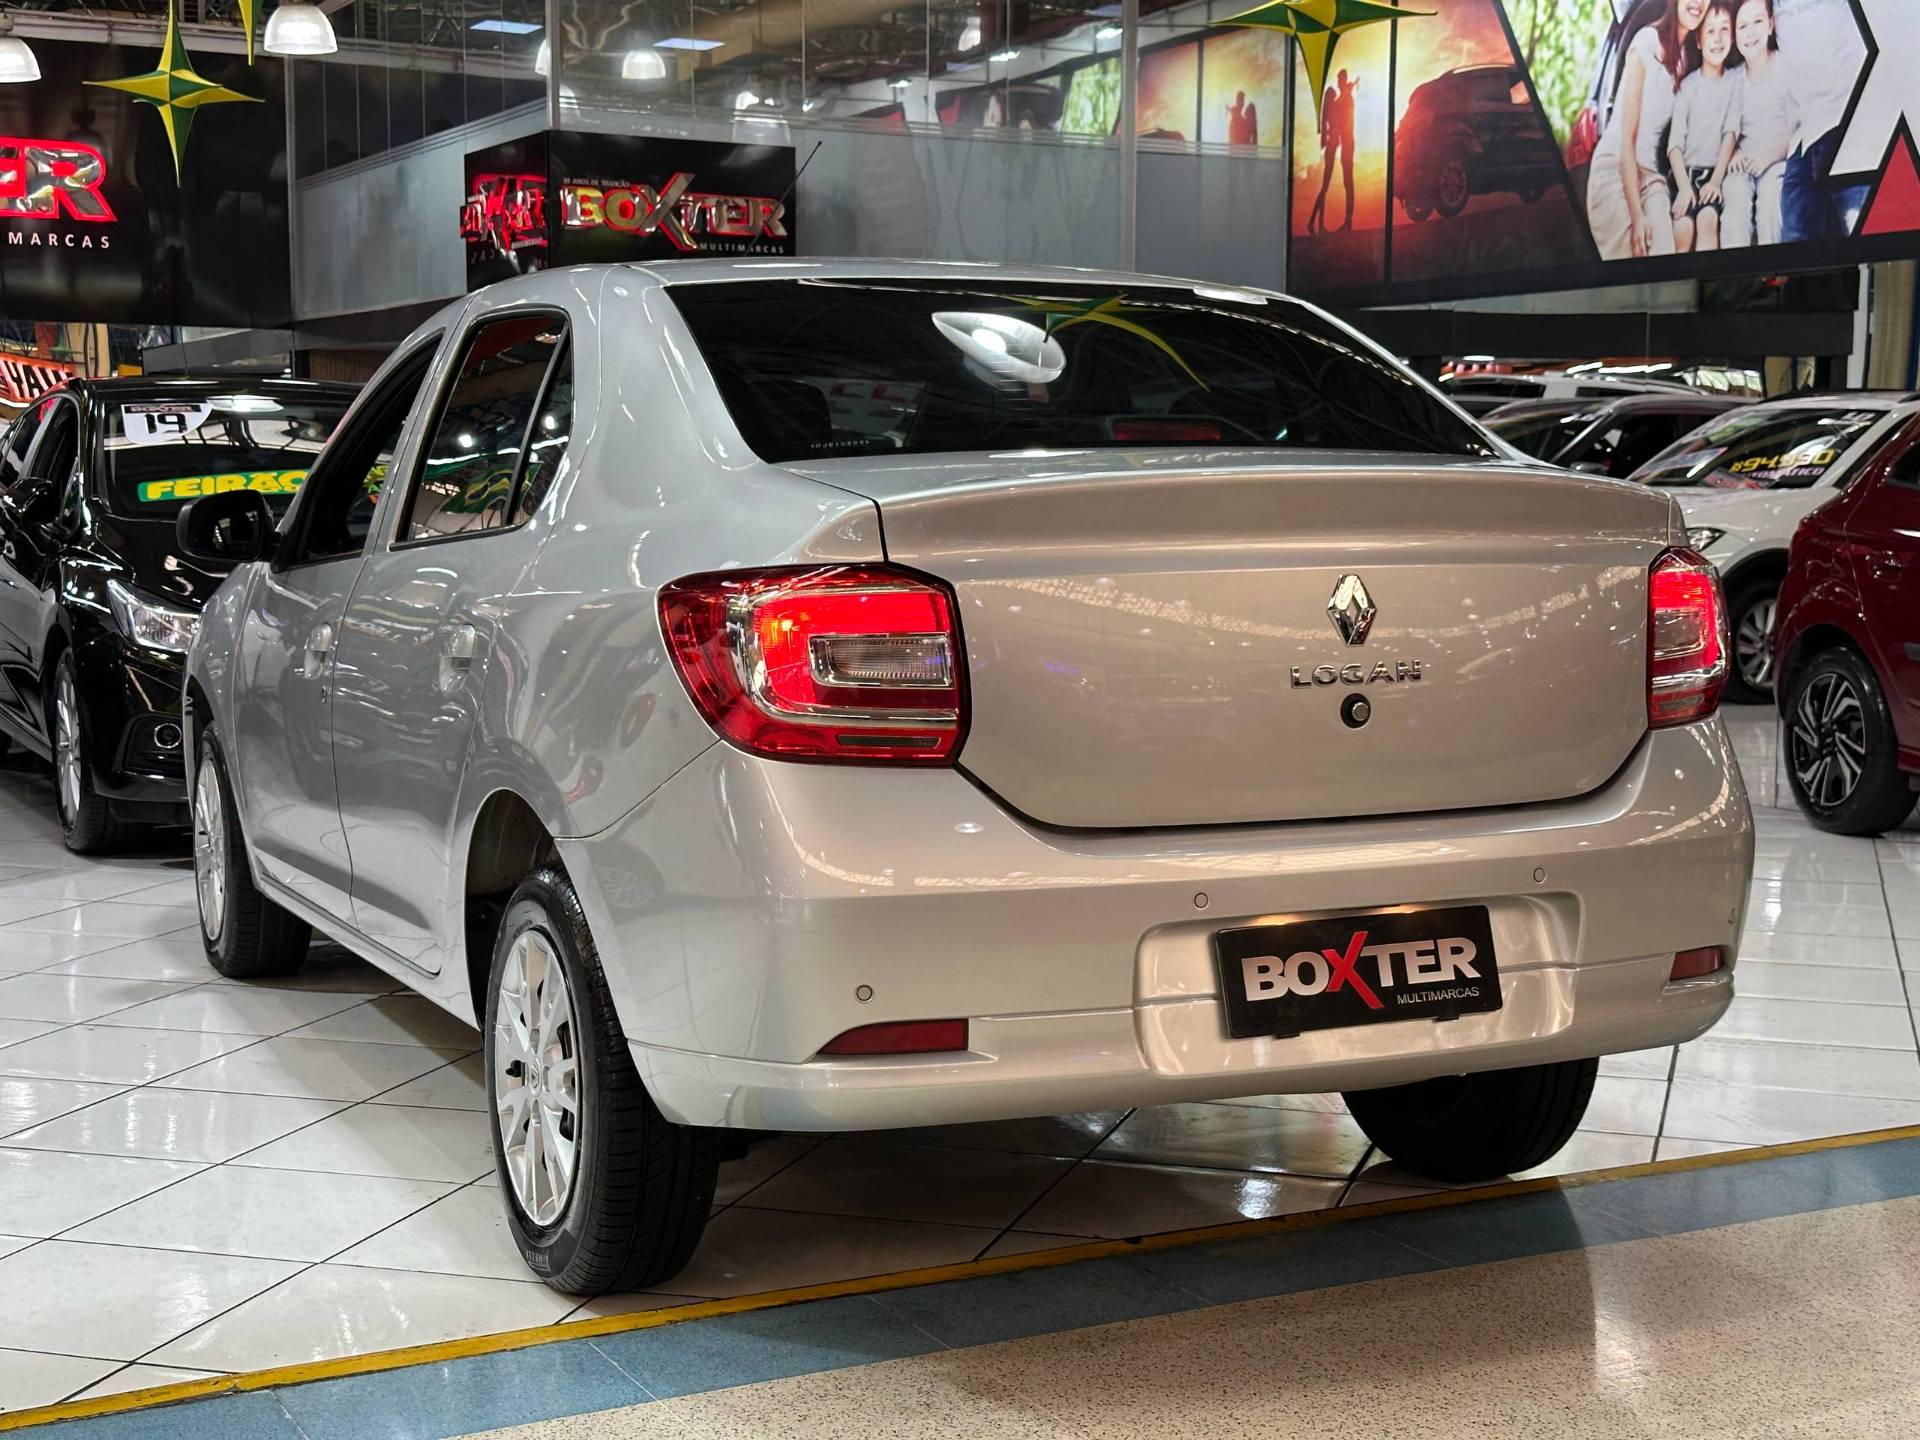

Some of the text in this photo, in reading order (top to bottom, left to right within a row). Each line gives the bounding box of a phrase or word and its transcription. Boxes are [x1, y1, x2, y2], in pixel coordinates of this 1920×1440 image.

[559, 171, 788, 251] BOXTER
[8, 231, 110, 249] MARCAS
[144, 413, 188, 433] 19
[1290, 659, 1422, 689] LOGAN
[1241, 930, 1482, 1010] BOXTER
[1396, 986, 1480, 1005] MULTIMARCAS
